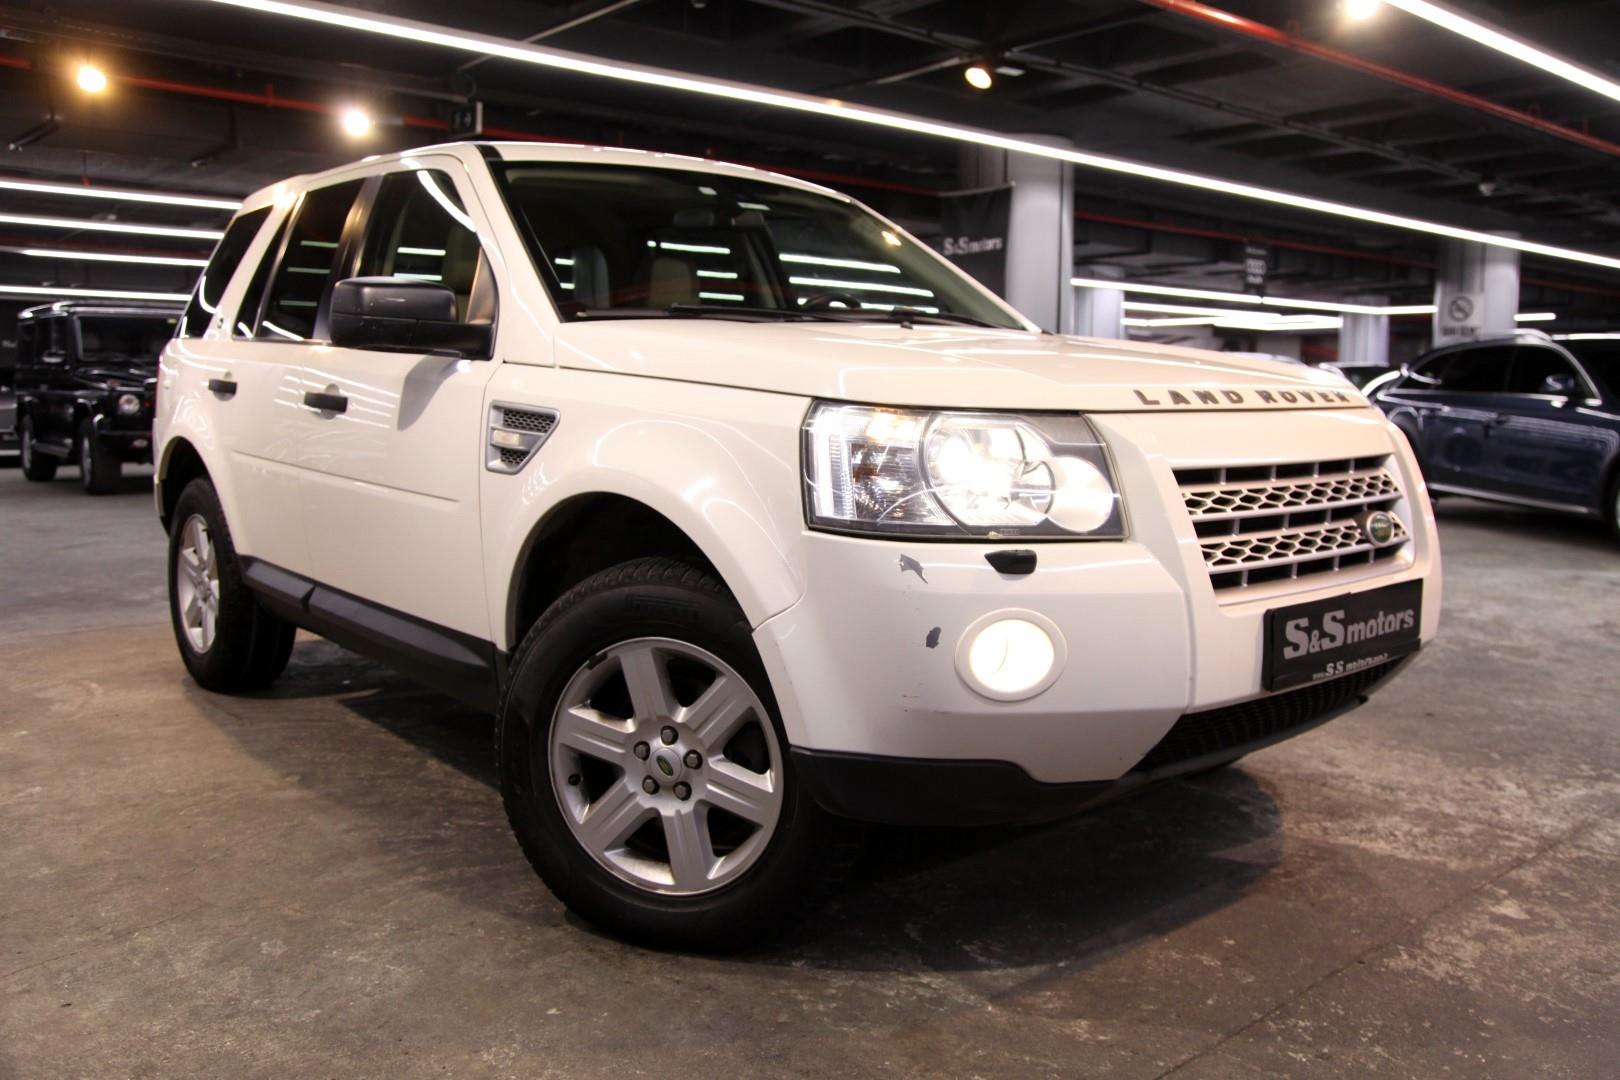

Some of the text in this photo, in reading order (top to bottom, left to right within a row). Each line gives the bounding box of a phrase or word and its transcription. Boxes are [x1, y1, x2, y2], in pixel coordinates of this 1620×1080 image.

[1133, 389, 1350, 406] LAND ROVER
[1346, 608, 1415, 644] motors
